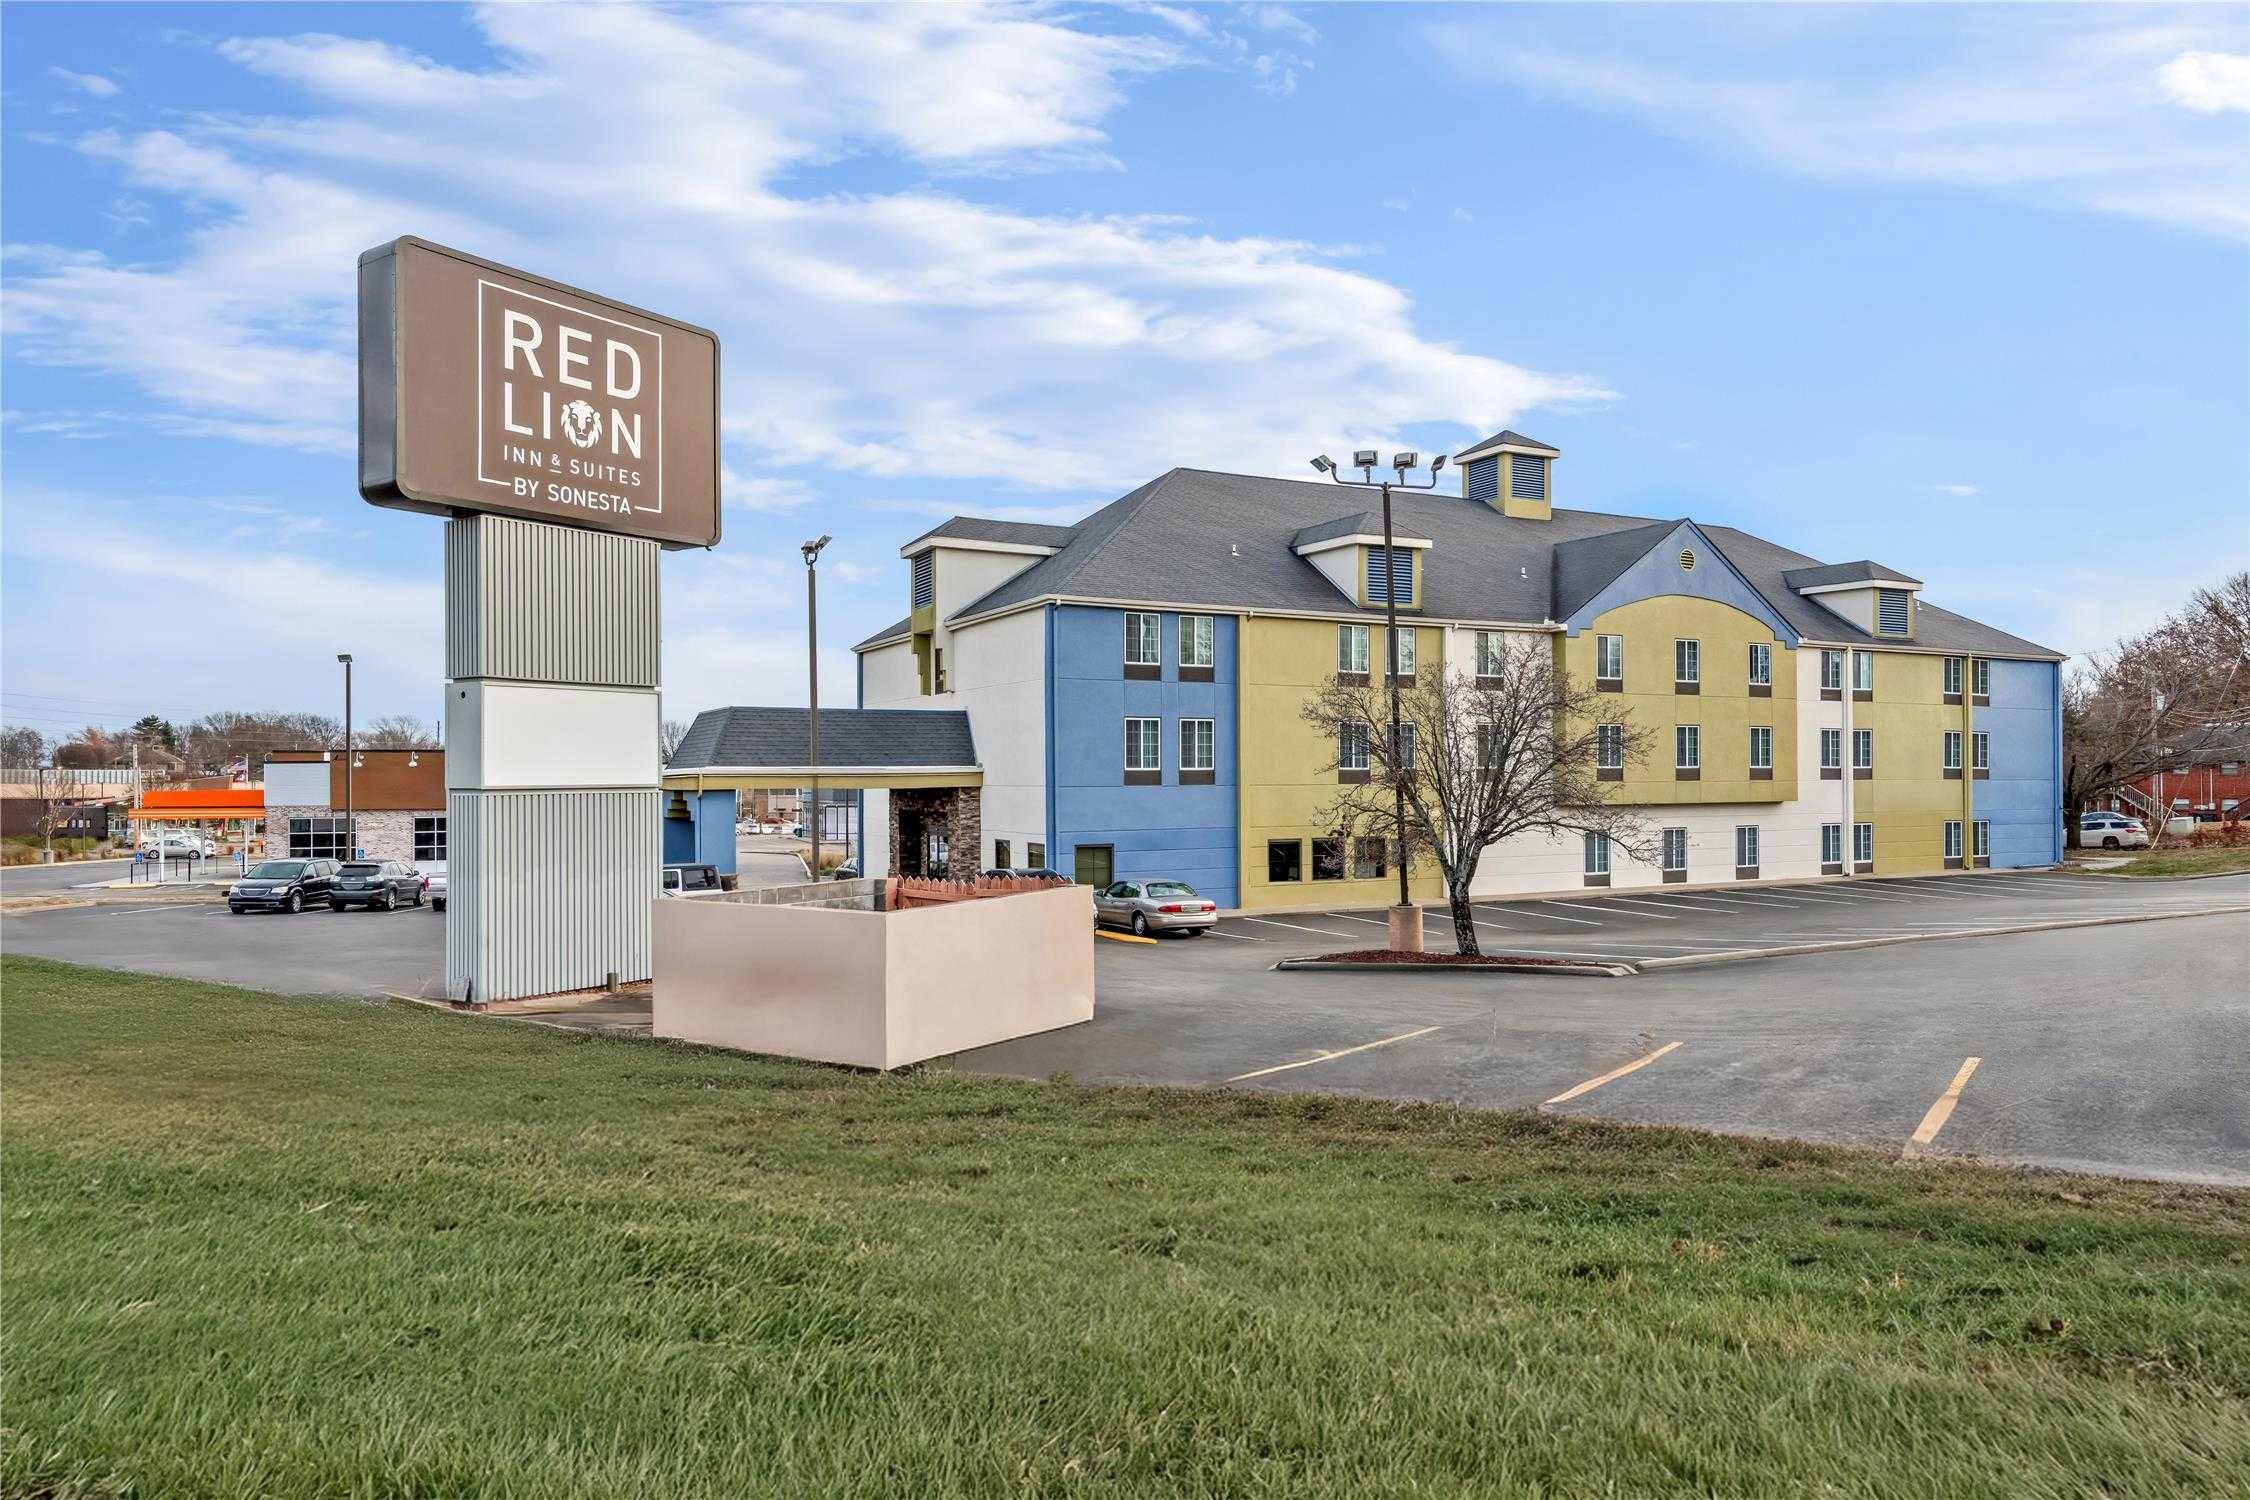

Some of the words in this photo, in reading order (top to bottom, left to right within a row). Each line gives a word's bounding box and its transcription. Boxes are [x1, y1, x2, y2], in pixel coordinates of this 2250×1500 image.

[504, 309, 641, 400] RED
[504, 445, 542, 467] INN
[551, 453, 562, 467] &
[570, 459, 641, 487] SUITES
[514, 478, 539, 498] BY
[548, 484, 632, 515] SONESTA
